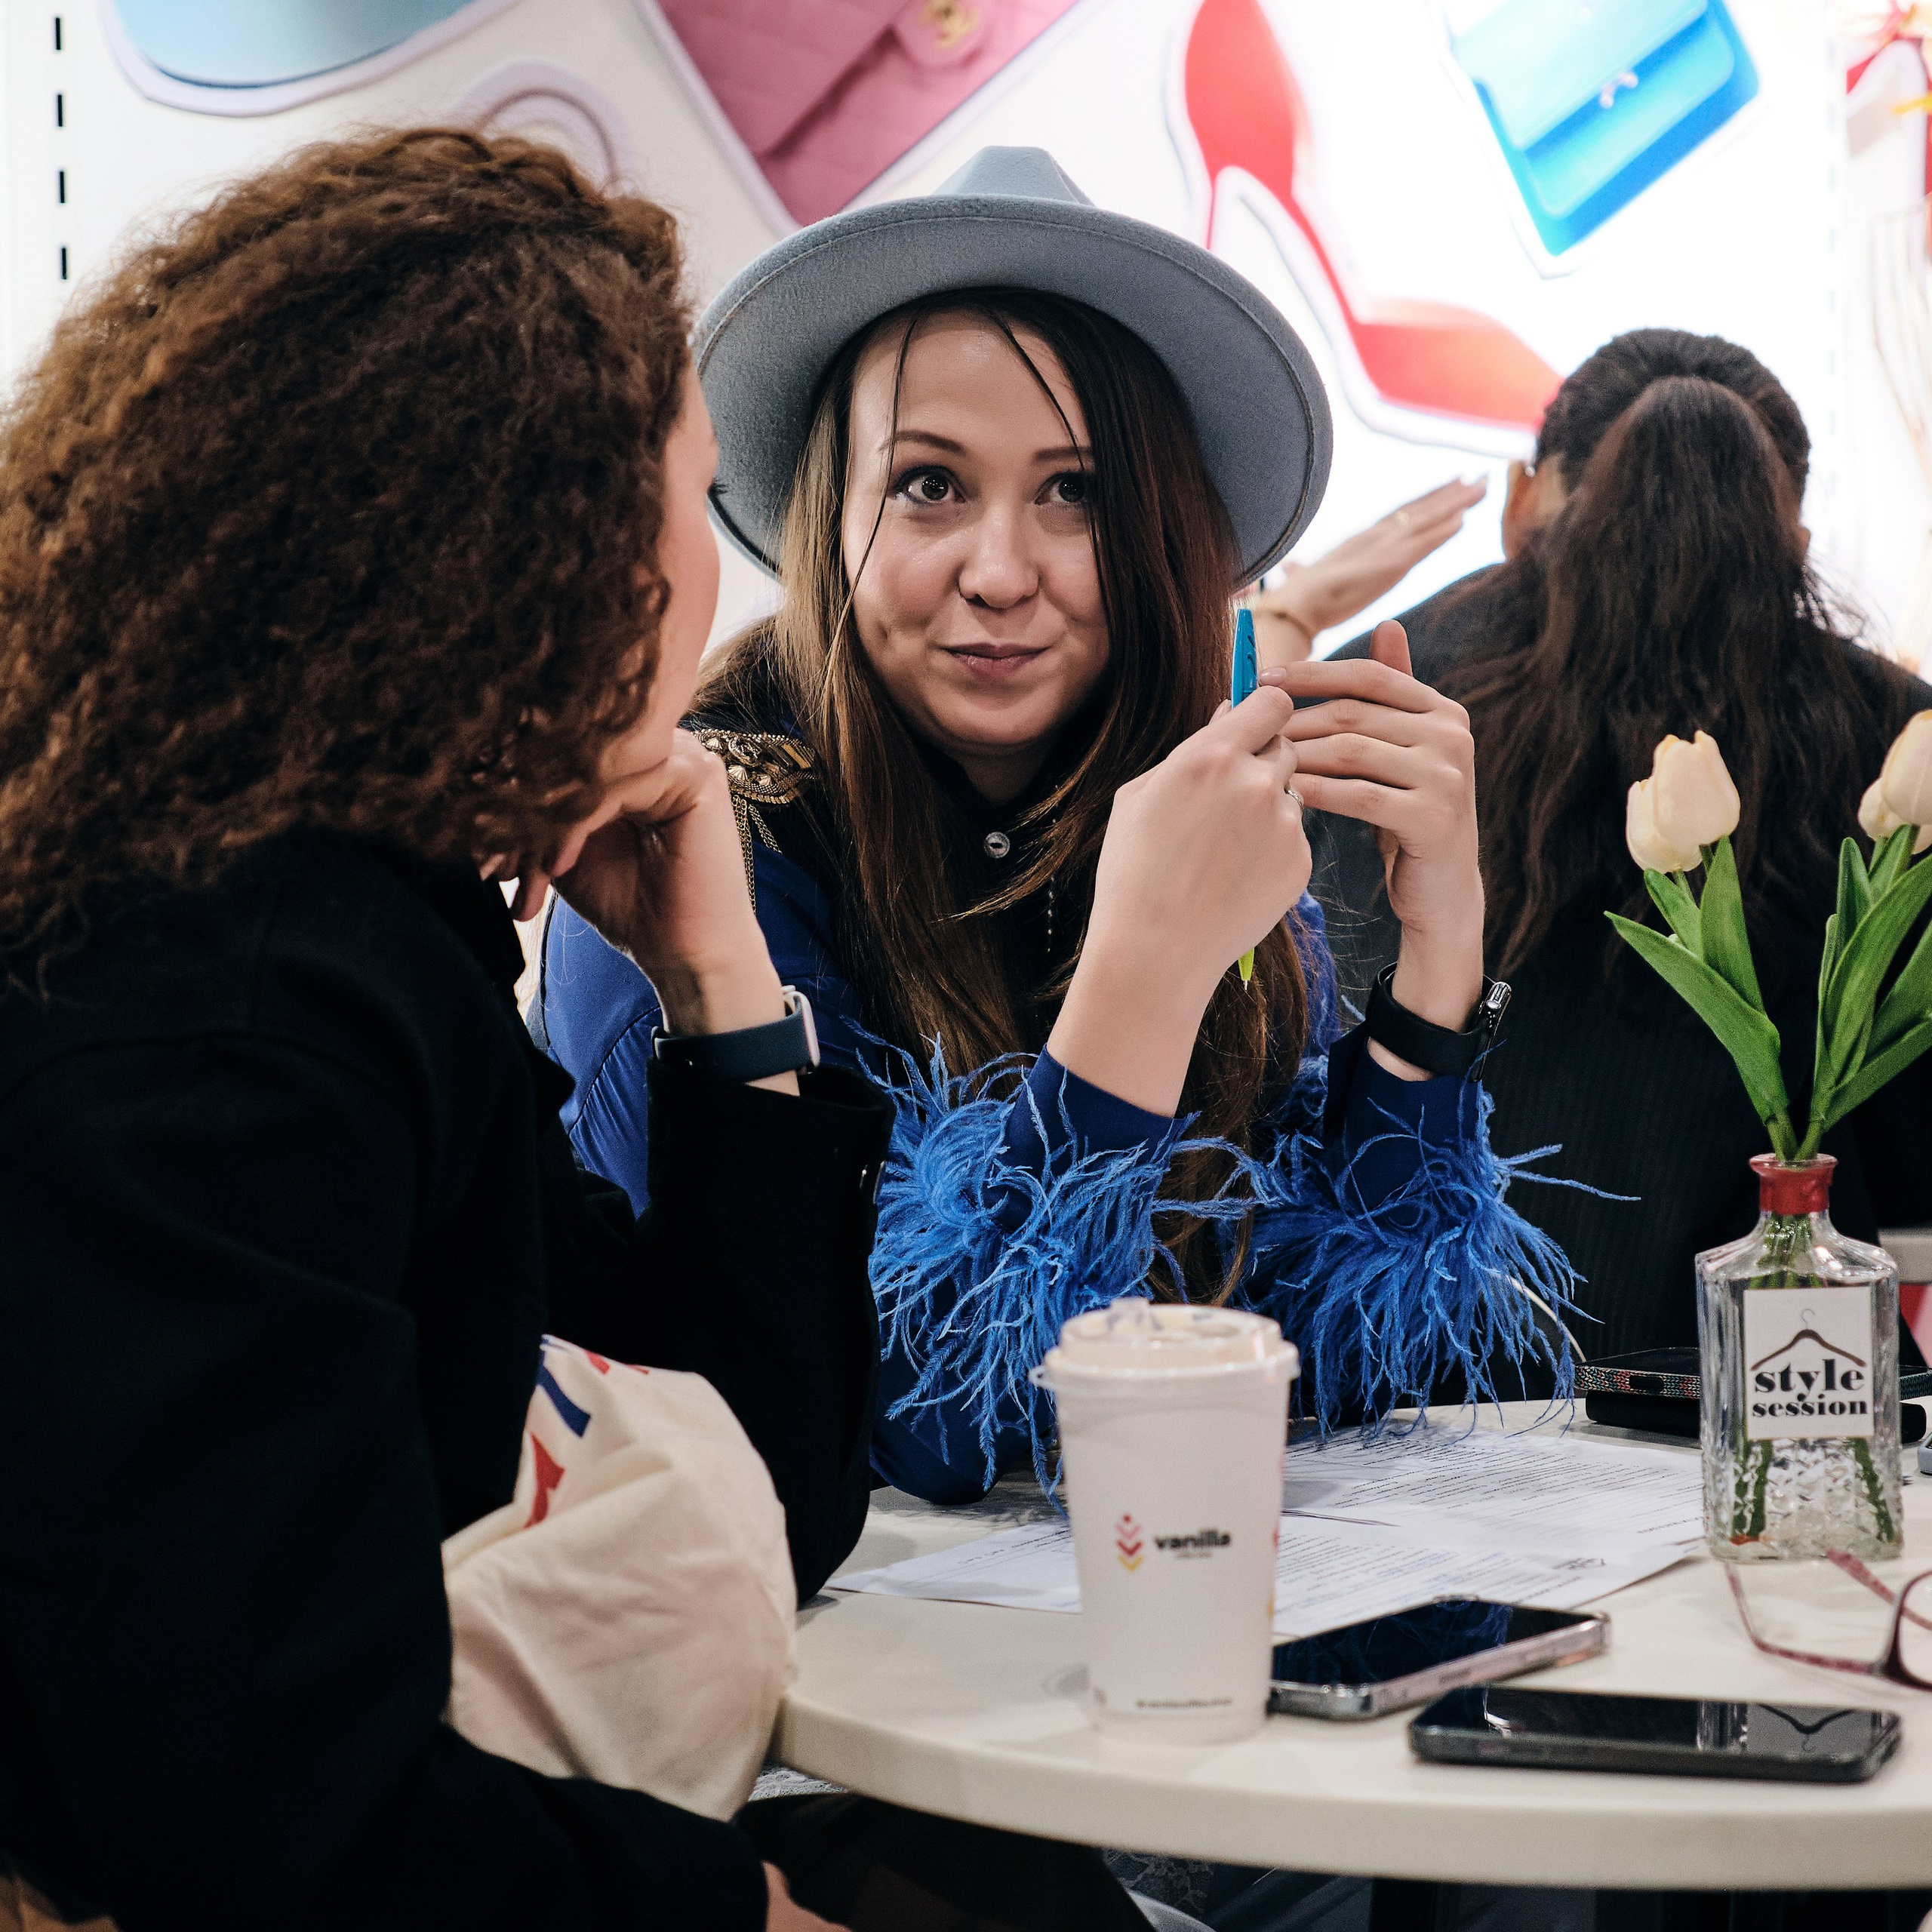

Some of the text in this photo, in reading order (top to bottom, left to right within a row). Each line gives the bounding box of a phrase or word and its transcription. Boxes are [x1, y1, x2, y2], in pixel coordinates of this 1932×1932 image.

[1755, 1359, 1865, 1401] style
[1752, 1394, 1868, 1417] session
[1155, 1528, 1230, 1549] vanilla
